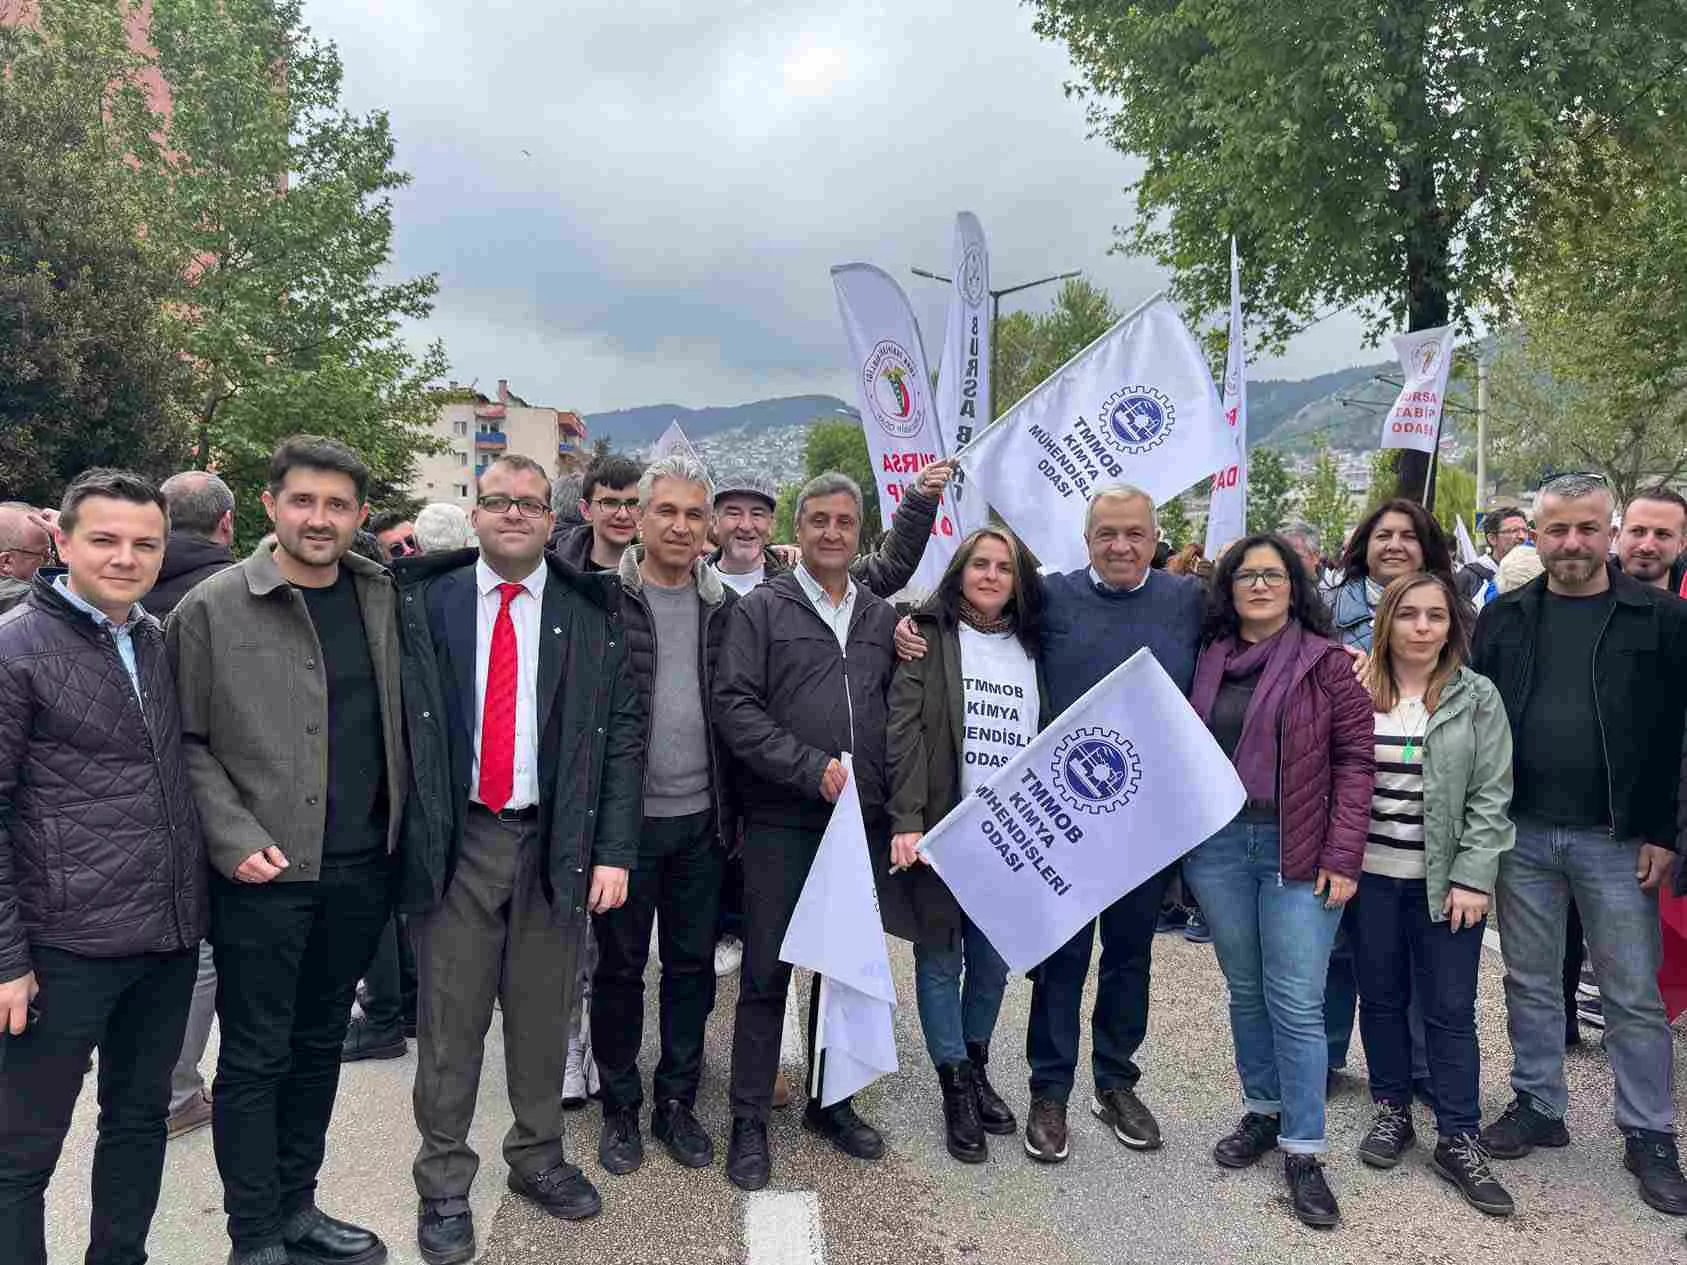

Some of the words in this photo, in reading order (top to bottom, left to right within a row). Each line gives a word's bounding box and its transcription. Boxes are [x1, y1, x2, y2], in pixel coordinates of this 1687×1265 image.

[1028, 423, 1093, 502] MÜHENDİSL
[1062, 433, 1099, 480] KİMYA
[1073, 415, 1124, 478] TMMOB
[1037, 458, 1073, 498] ODASI
[963, 678, 1024, 699] TMMOB
[967, 700, 1019, 722] KİMYA
[962, 726, 1032, 748] ENDİSL
[1009, 791, 1056, 849] KİMYA
[1020, 767, 1084, 844] TMMOB
[981, 820, 1025, 873] ODASI
